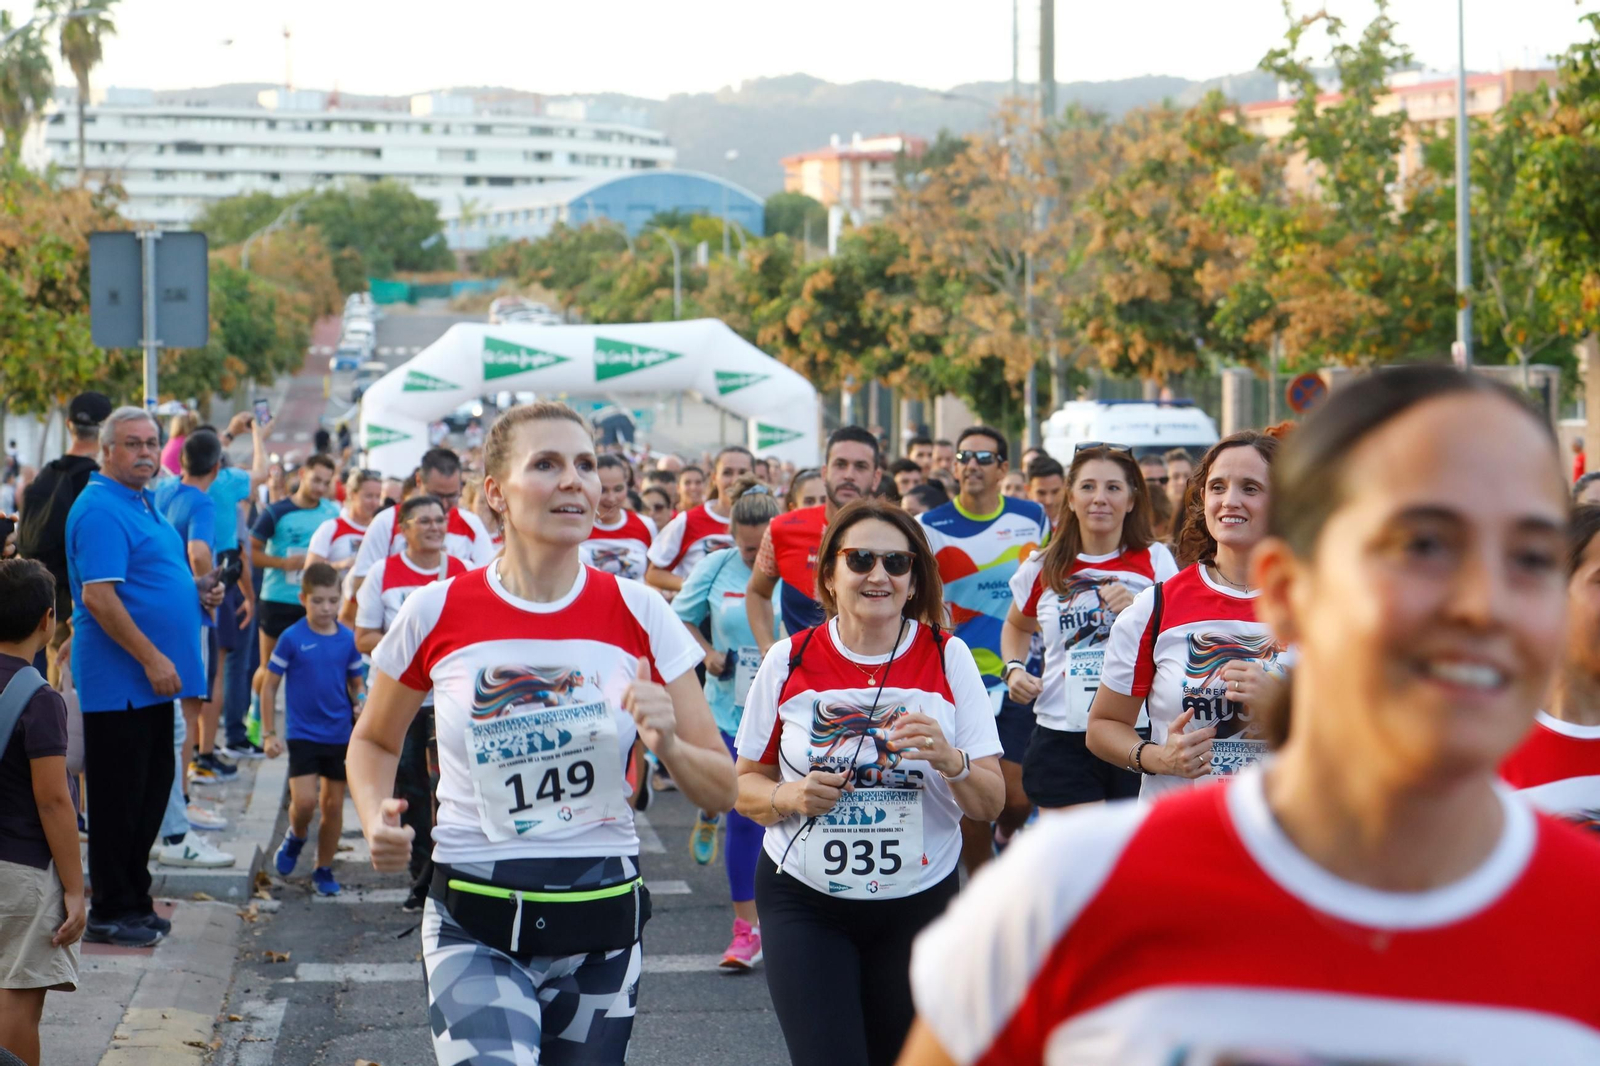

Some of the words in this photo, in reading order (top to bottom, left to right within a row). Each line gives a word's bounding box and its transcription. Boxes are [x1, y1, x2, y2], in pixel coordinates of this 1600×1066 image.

[977, 580, 1009, 591] Mála
[991, 590, 1013, 599] 20
[1183, 686, 1227, 696] CARRER
[1182, 696, 1252, 722] MUJ
[1210, 756, 1249, 766] 024
[505, 759, 595, 815] 149
[823, 839, 902, 876] 935
